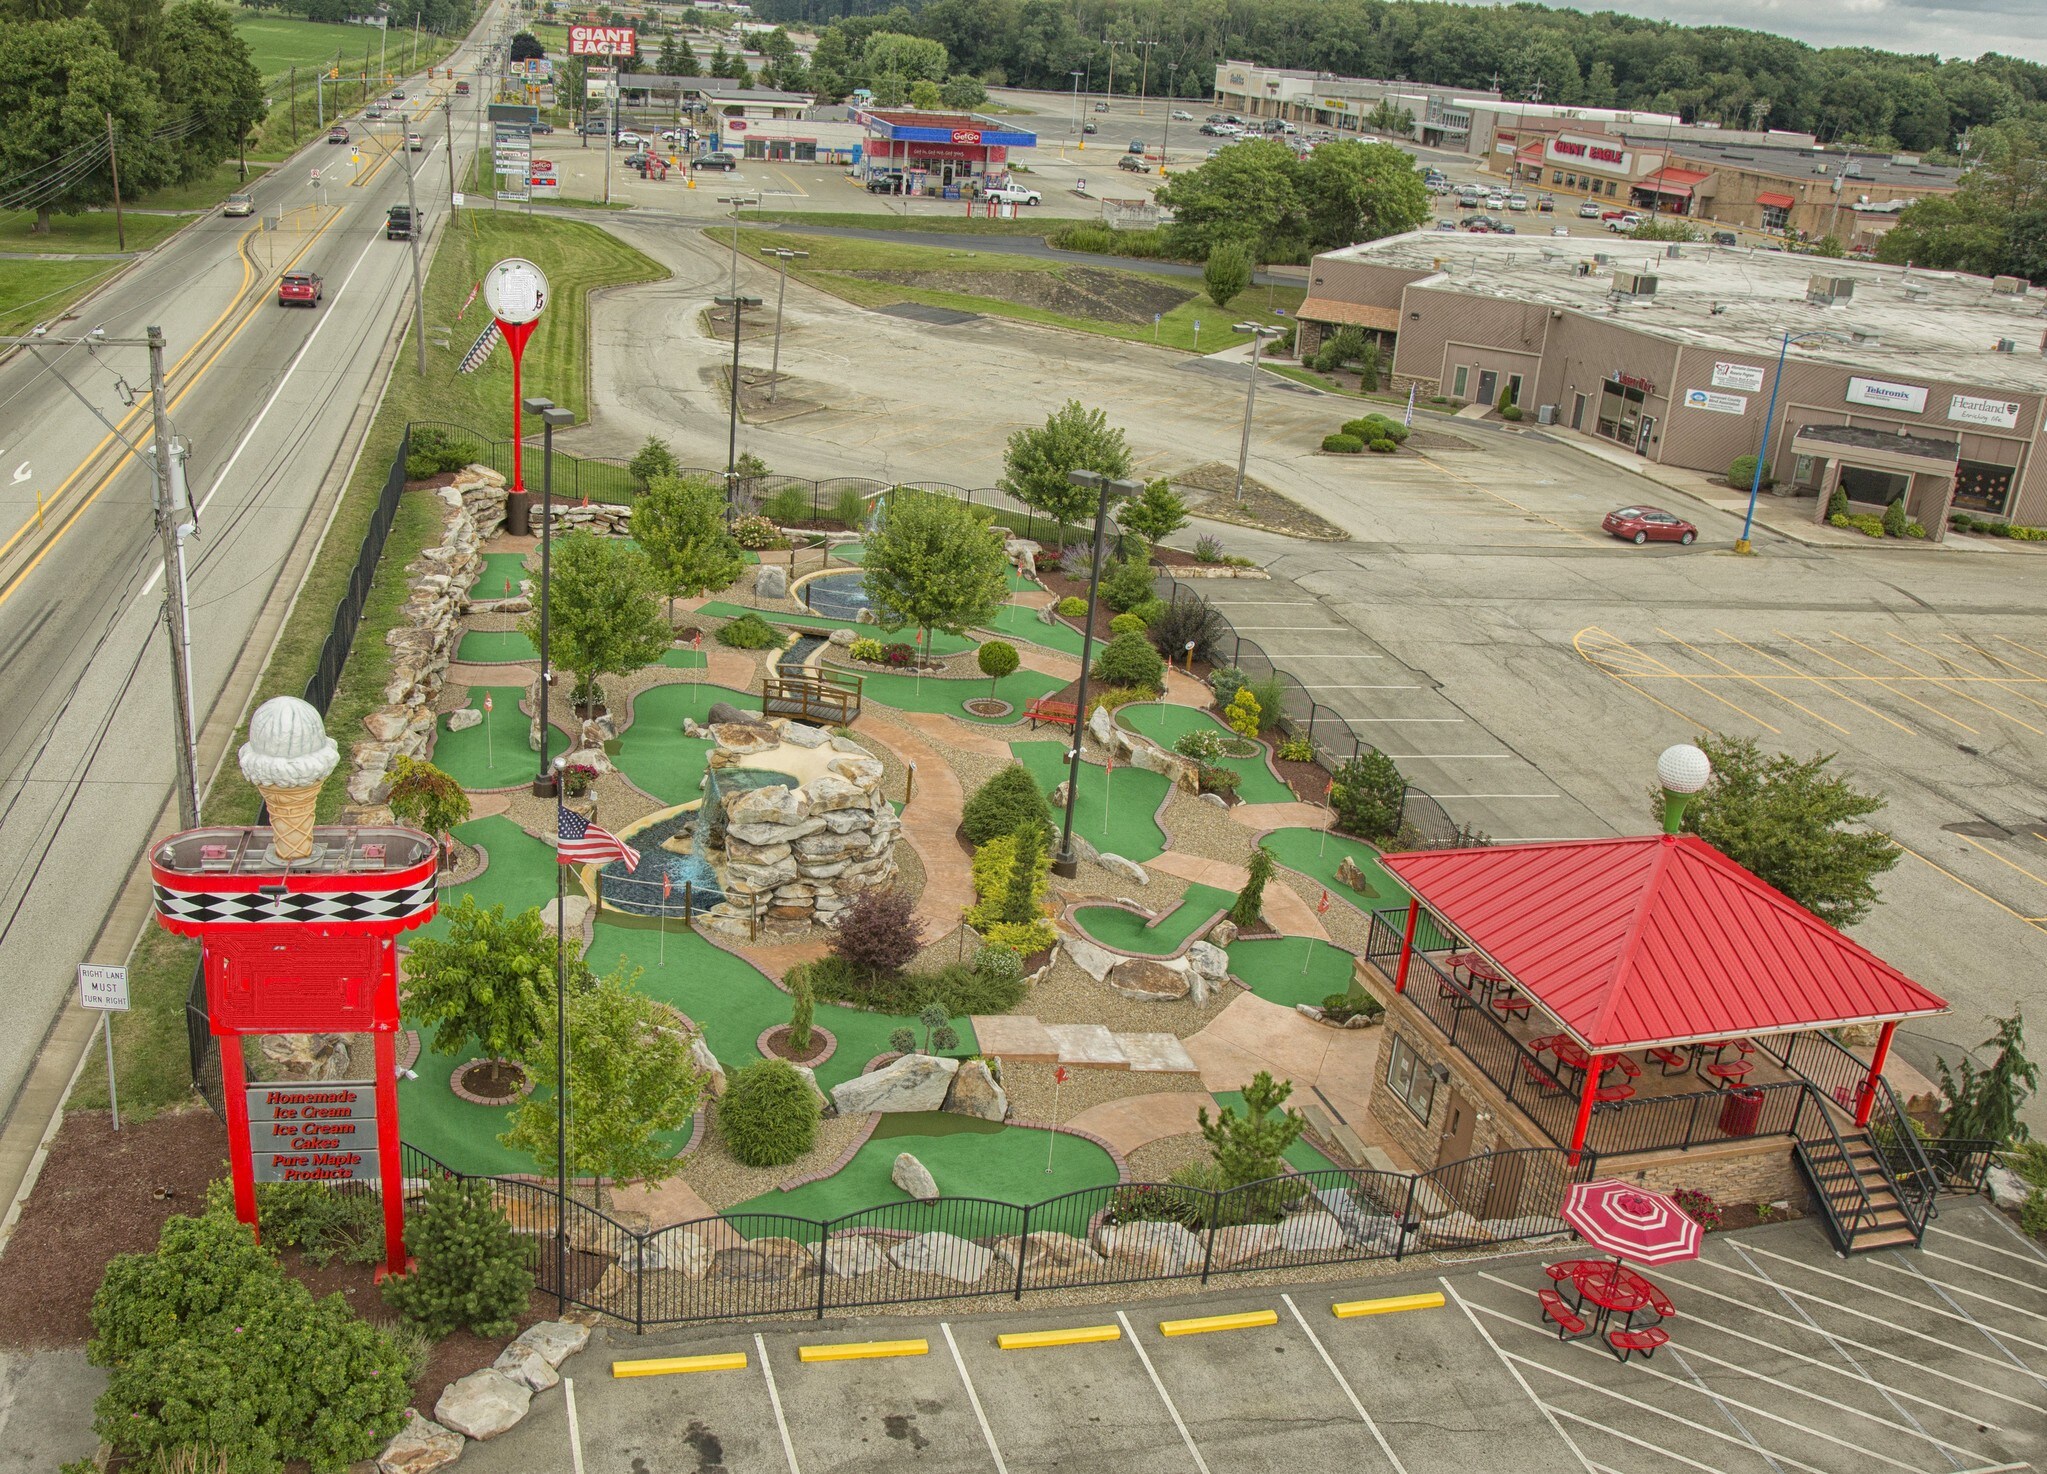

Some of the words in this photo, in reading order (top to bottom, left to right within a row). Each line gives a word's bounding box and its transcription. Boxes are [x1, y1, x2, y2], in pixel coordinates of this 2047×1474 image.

[571, 27, 632, 42] GIANT
[573, 41, 631, 55] EAGLE
[953, 132, 979, 141] GetGo
[1554, 140, 1587, 157] GIANT
[1589, 146, 1623, 164] EAGLE
[1865, 385, 1910, 399] Tektronix
[1952, 396, 2006, 414] Heartland
[1961, 410, 1988, 423] Enriching
[82, 969, 103, 978] RIGHT
[106, 972, 125, 980] LANE
[92, 982, 117, 992] MUST
[84, 995, 103, 1003] TURN
[106, 996, 127, 1005] RIGHT
[266, 1089, 357, 1104] Homemade
[272, 1106, 298, 1119] Ice
[300, 1105, 352, 1118] Cream
[272, 1123, 298, 1136] Ice
[301, 1122, 356, 1135] Cream
[290, 1136, 340, 1150] Cakes
[272, 1153, 309, 1168] Pure
[311, 1152, 362, 1168] Maple
[283, 1166, 354, 1181] Products
